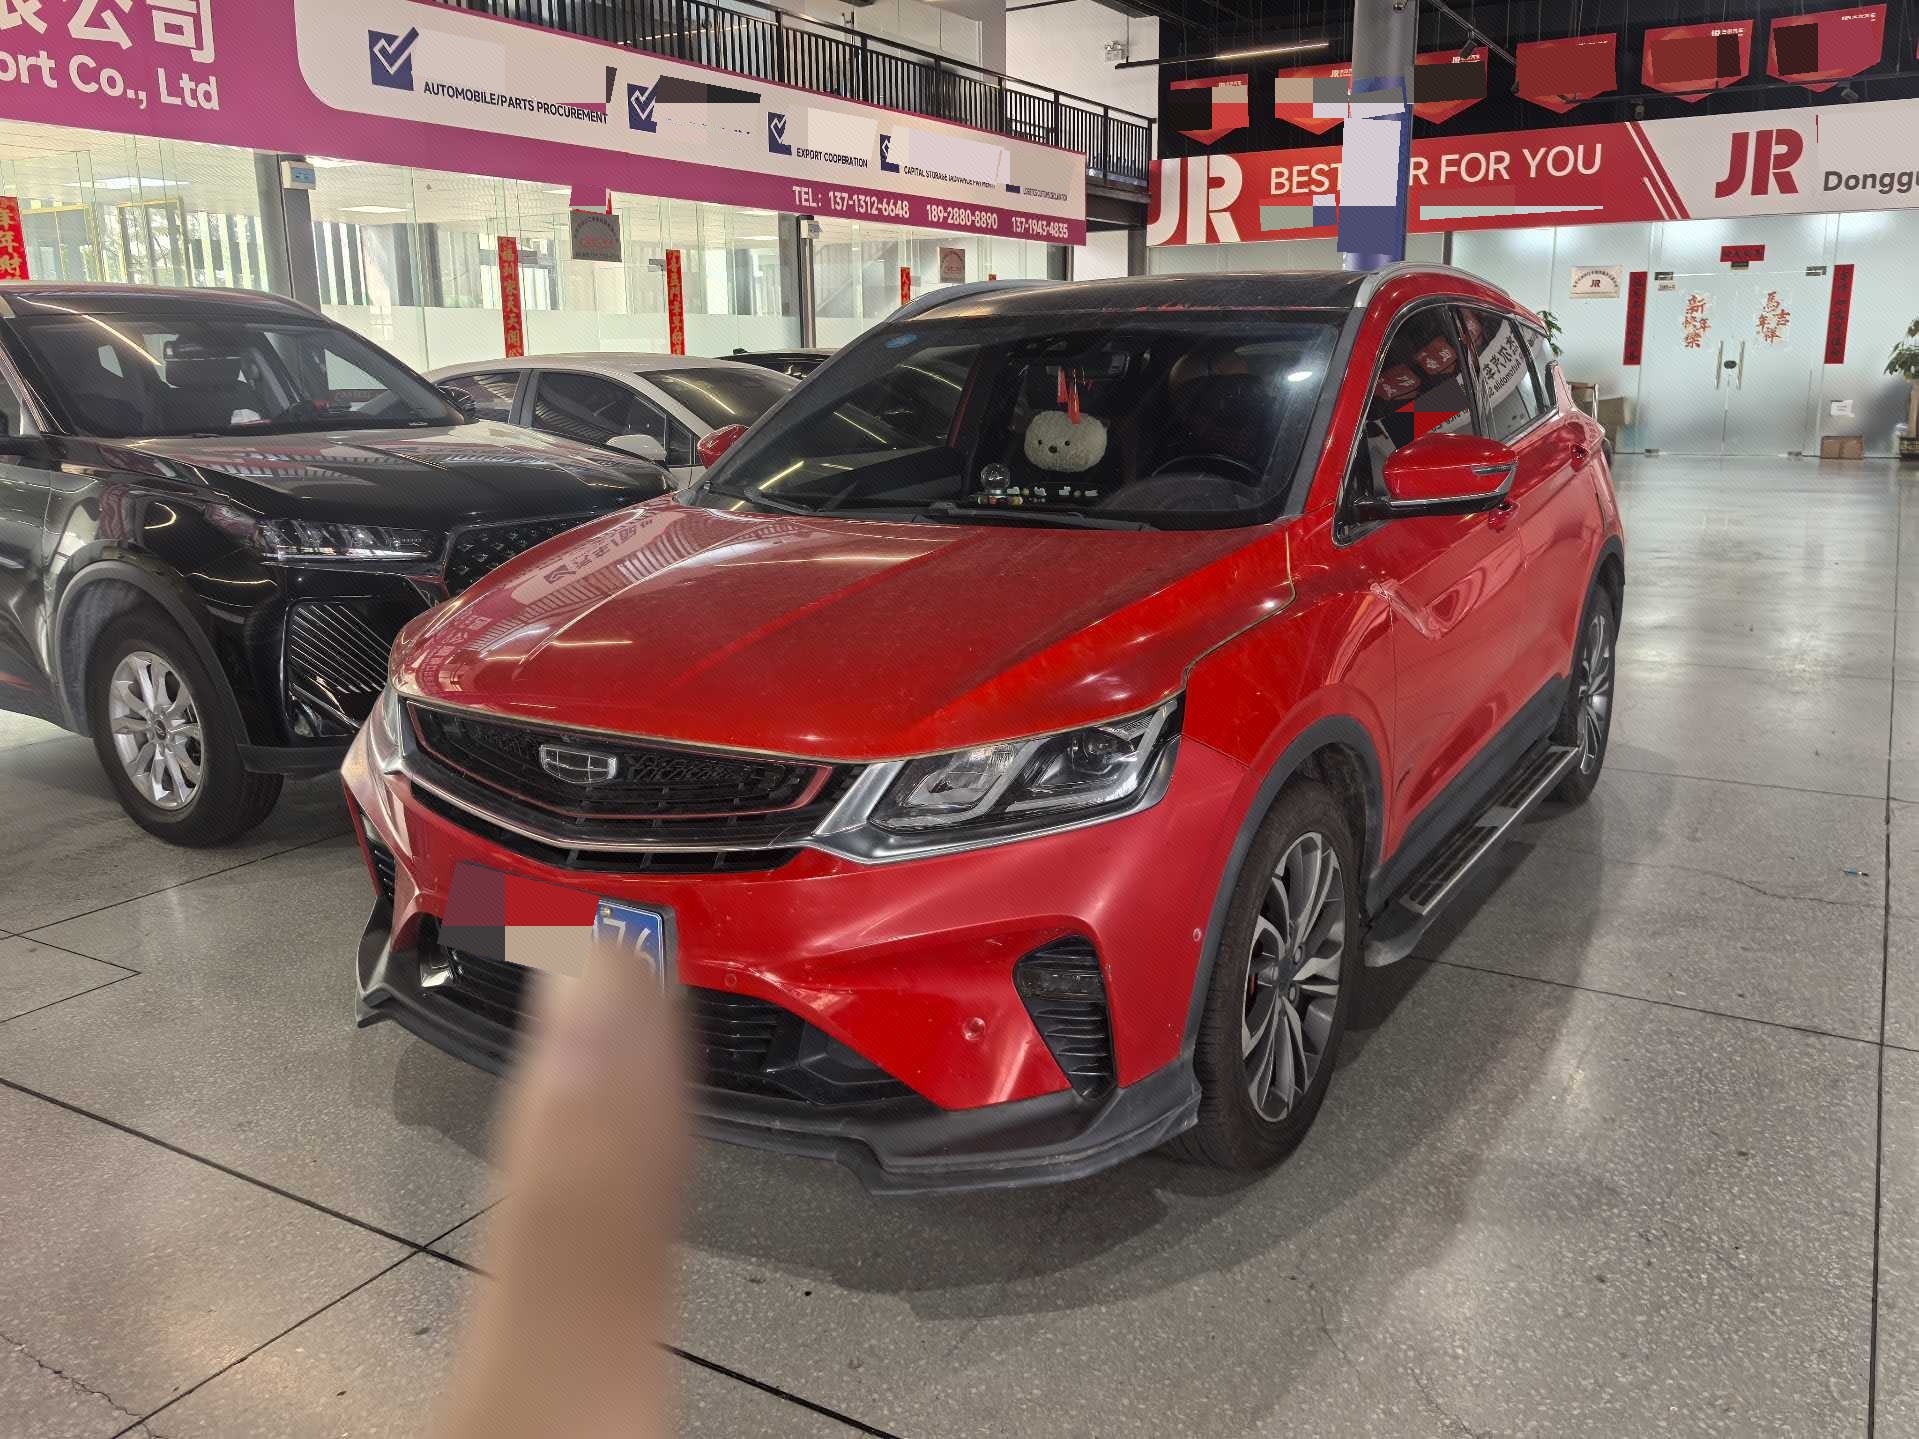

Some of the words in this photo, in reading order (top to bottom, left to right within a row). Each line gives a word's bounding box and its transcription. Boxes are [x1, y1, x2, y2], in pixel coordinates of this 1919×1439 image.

[68, 54, 147, 109] Co.,
[157, 67, 219, 110] Ltd
[423, 81, 535, 112] AUTOMOBILE/PARTS
[536, 102, 608, 125] PROCUREMENT
[796, 147, 822, 160] EXPORT
[823, 152, 868, 168] COOPERATION
[1439, 150, 1511, 184] FOR
[1522, 143, 1602, 179] YOU
[1714, 128, 1804, 199] JR
[828, 191, 910, 219] 137-1312-6648
[926, 203, 998, 230] 189-2880-8890
[1011, 216, 1069, 239] 137-1943-4835
